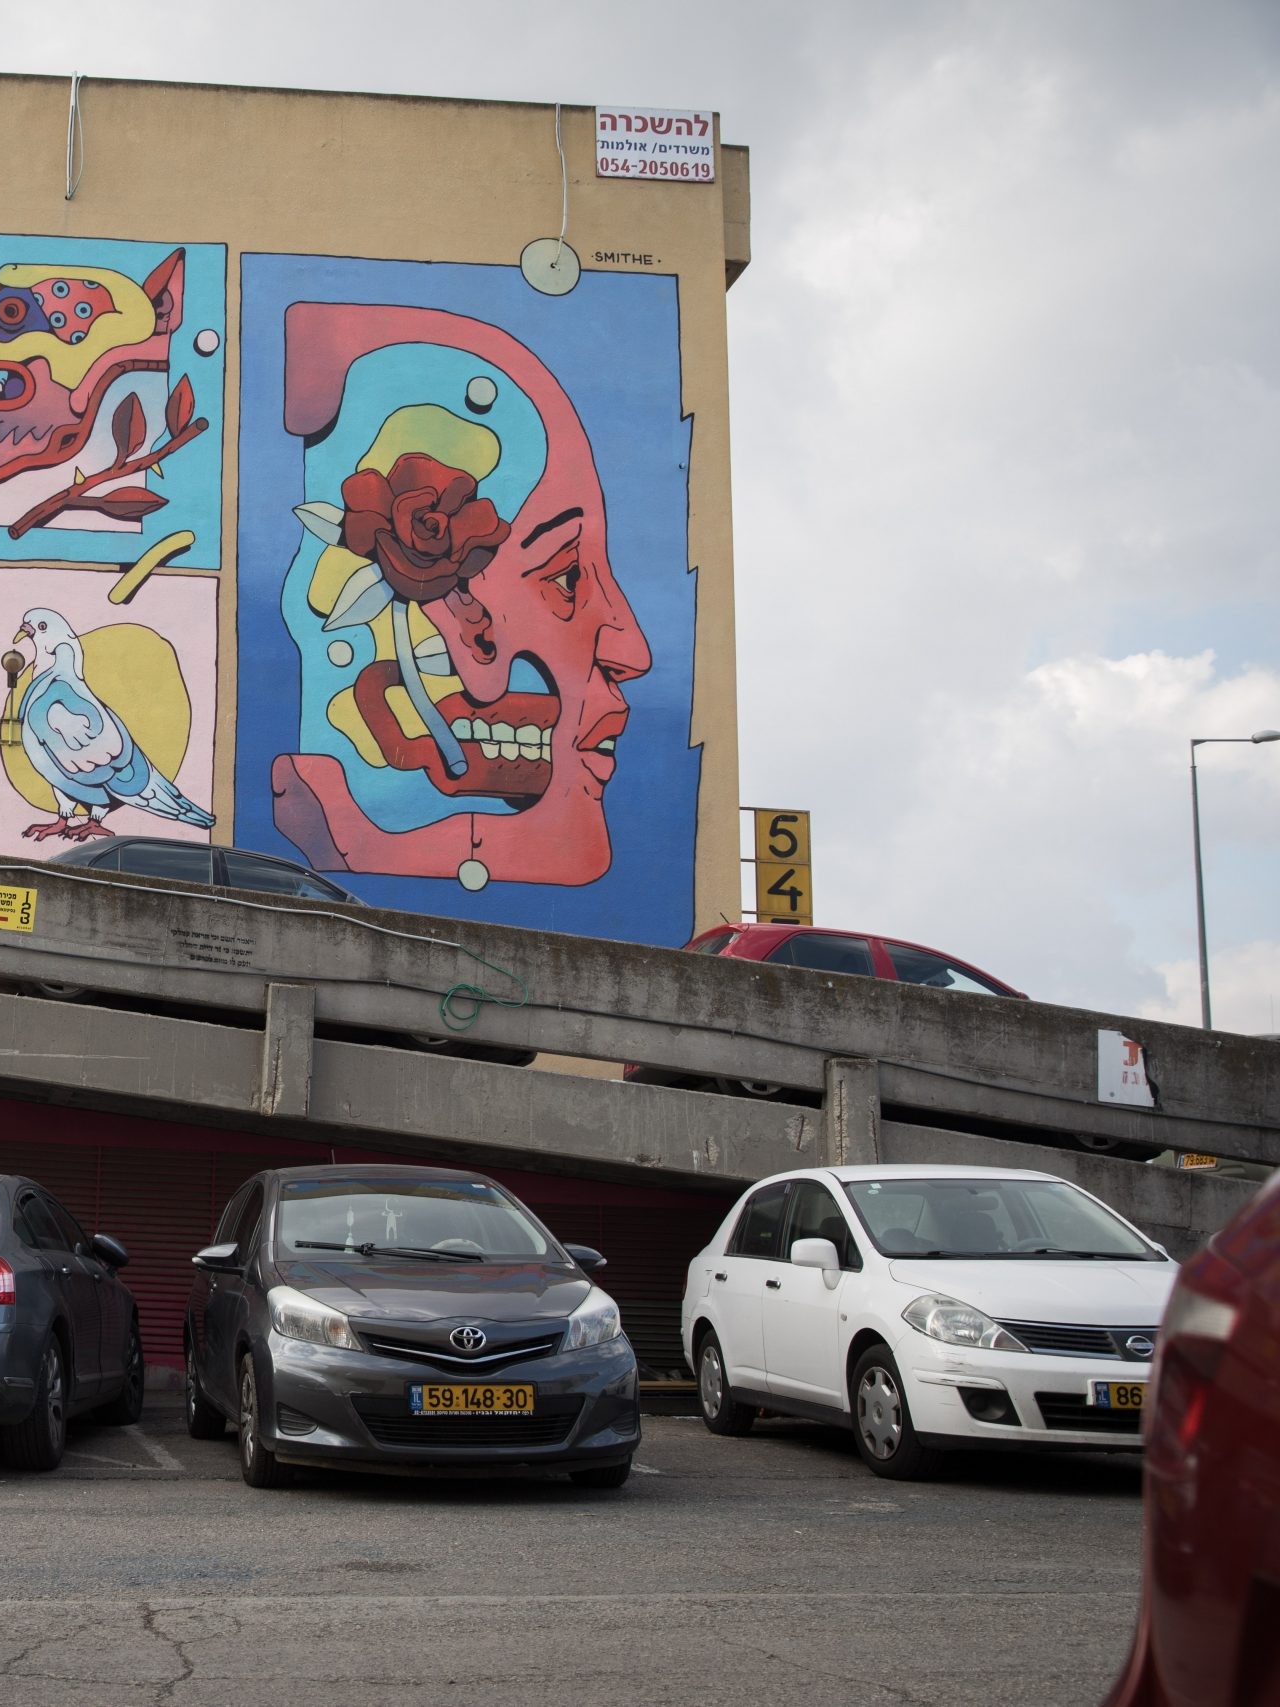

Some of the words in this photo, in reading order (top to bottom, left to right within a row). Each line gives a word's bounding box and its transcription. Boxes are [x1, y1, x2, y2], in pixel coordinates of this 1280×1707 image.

[599, 113, 709, 137] להשכרה
[599, 139, 648, 152] אולמות
[599, 157, 710, 178] 054-2050619
[768, 814, 799, 858] 5
[767, 868, 804, 912] 4
